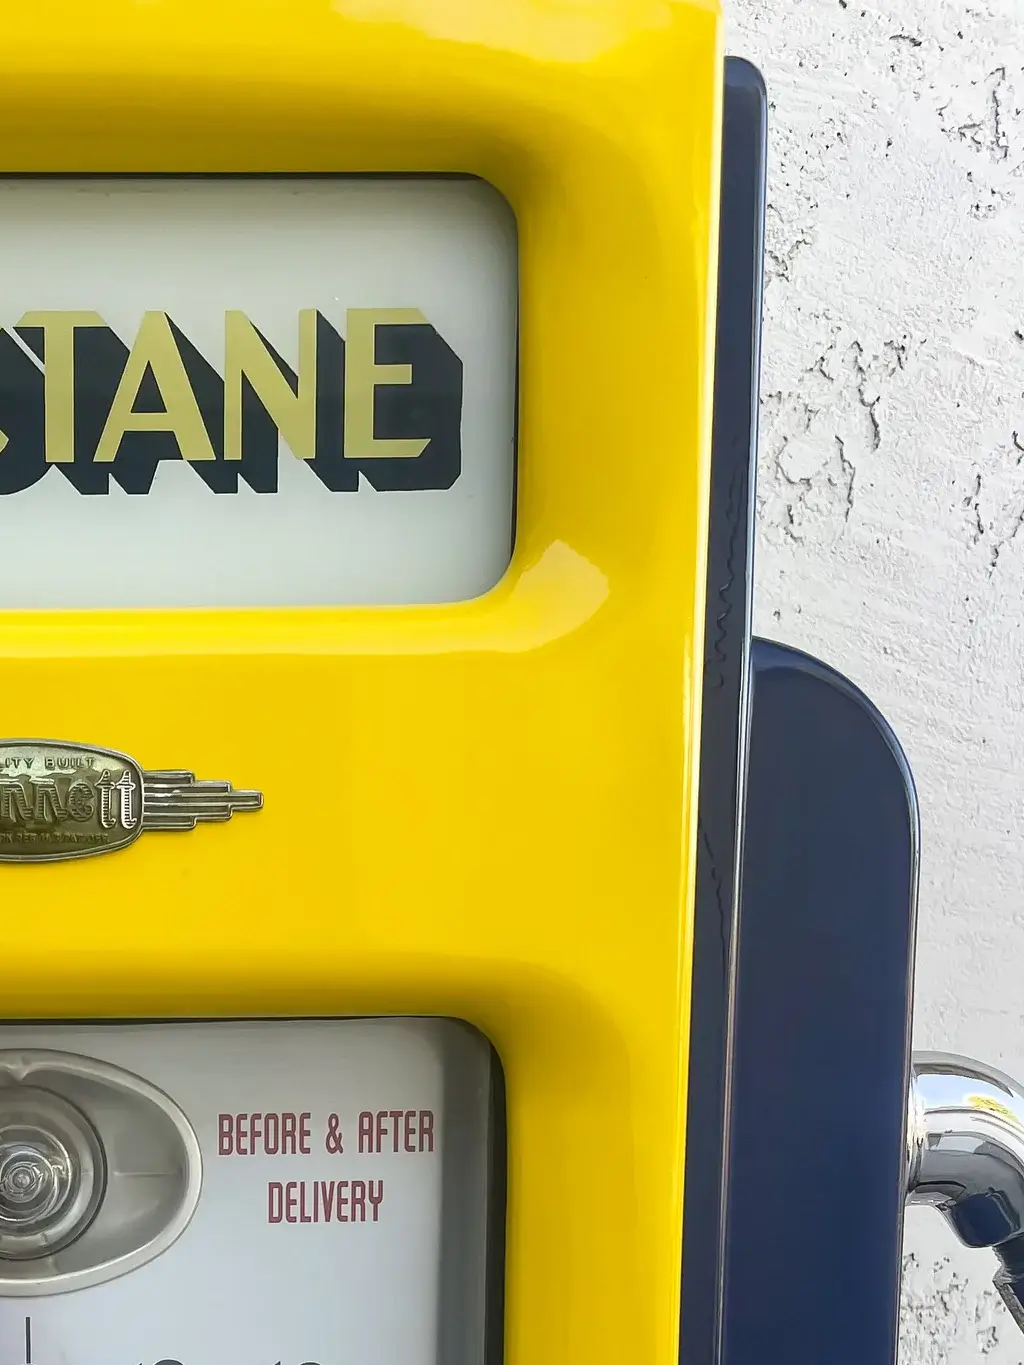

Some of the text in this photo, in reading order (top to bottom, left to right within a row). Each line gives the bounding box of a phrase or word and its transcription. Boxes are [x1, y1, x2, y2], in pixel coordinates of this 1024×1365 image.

[45, 755, 95, 771] BUILT
[218, 1109, 435, 1156] BEFORE & AFTER
[268, 1179, 384, 1224] DELIVERY
